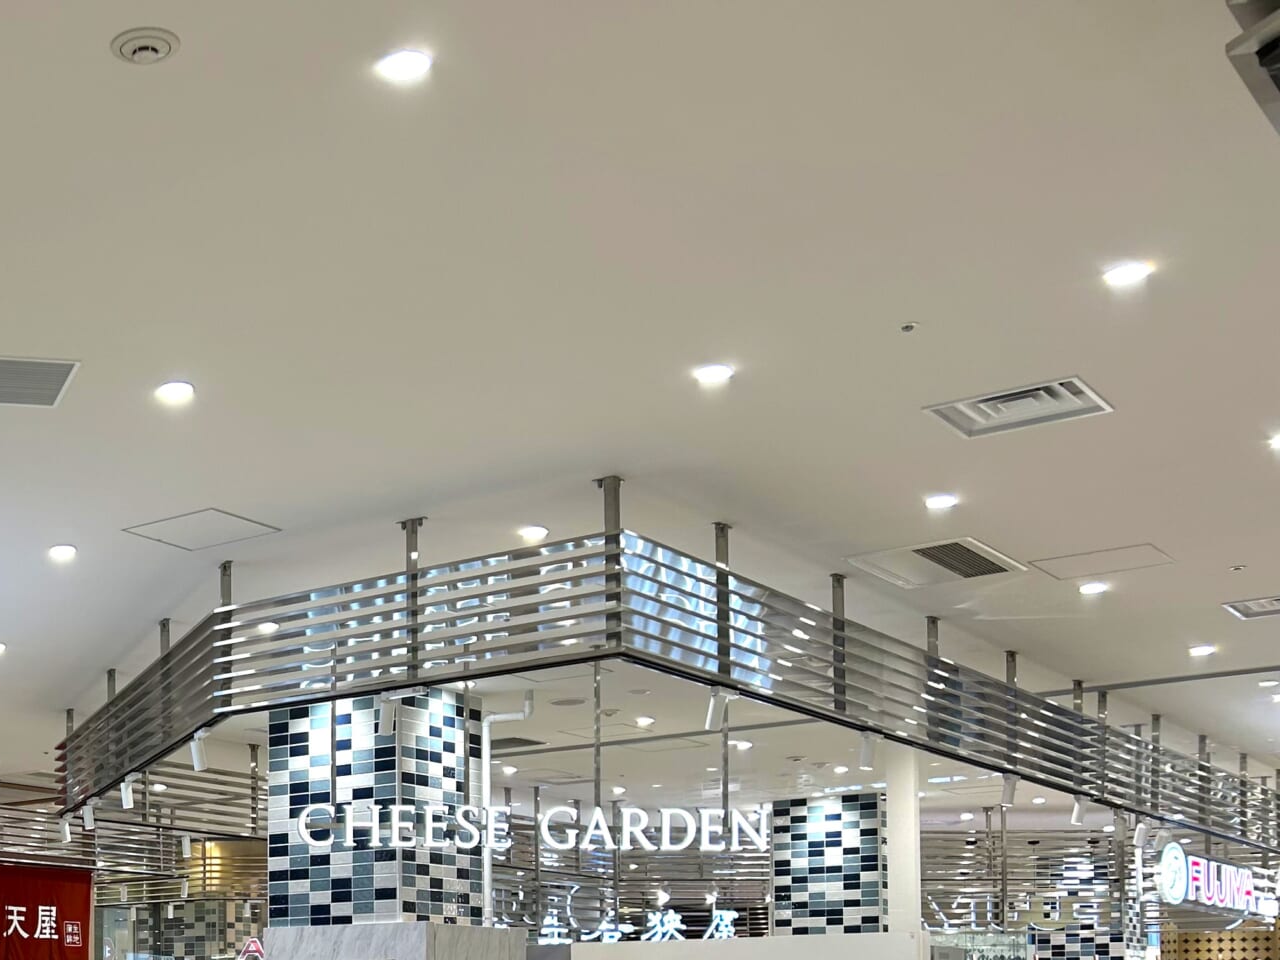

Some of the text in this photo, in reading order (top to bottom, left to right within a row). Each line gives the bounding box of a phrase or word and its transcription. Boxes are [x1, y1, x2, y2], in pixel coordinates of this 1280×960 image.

[296, 804, 772, 851] CHEESE GARDEN
[1186, 855, 1257, 912] FUJIYA
